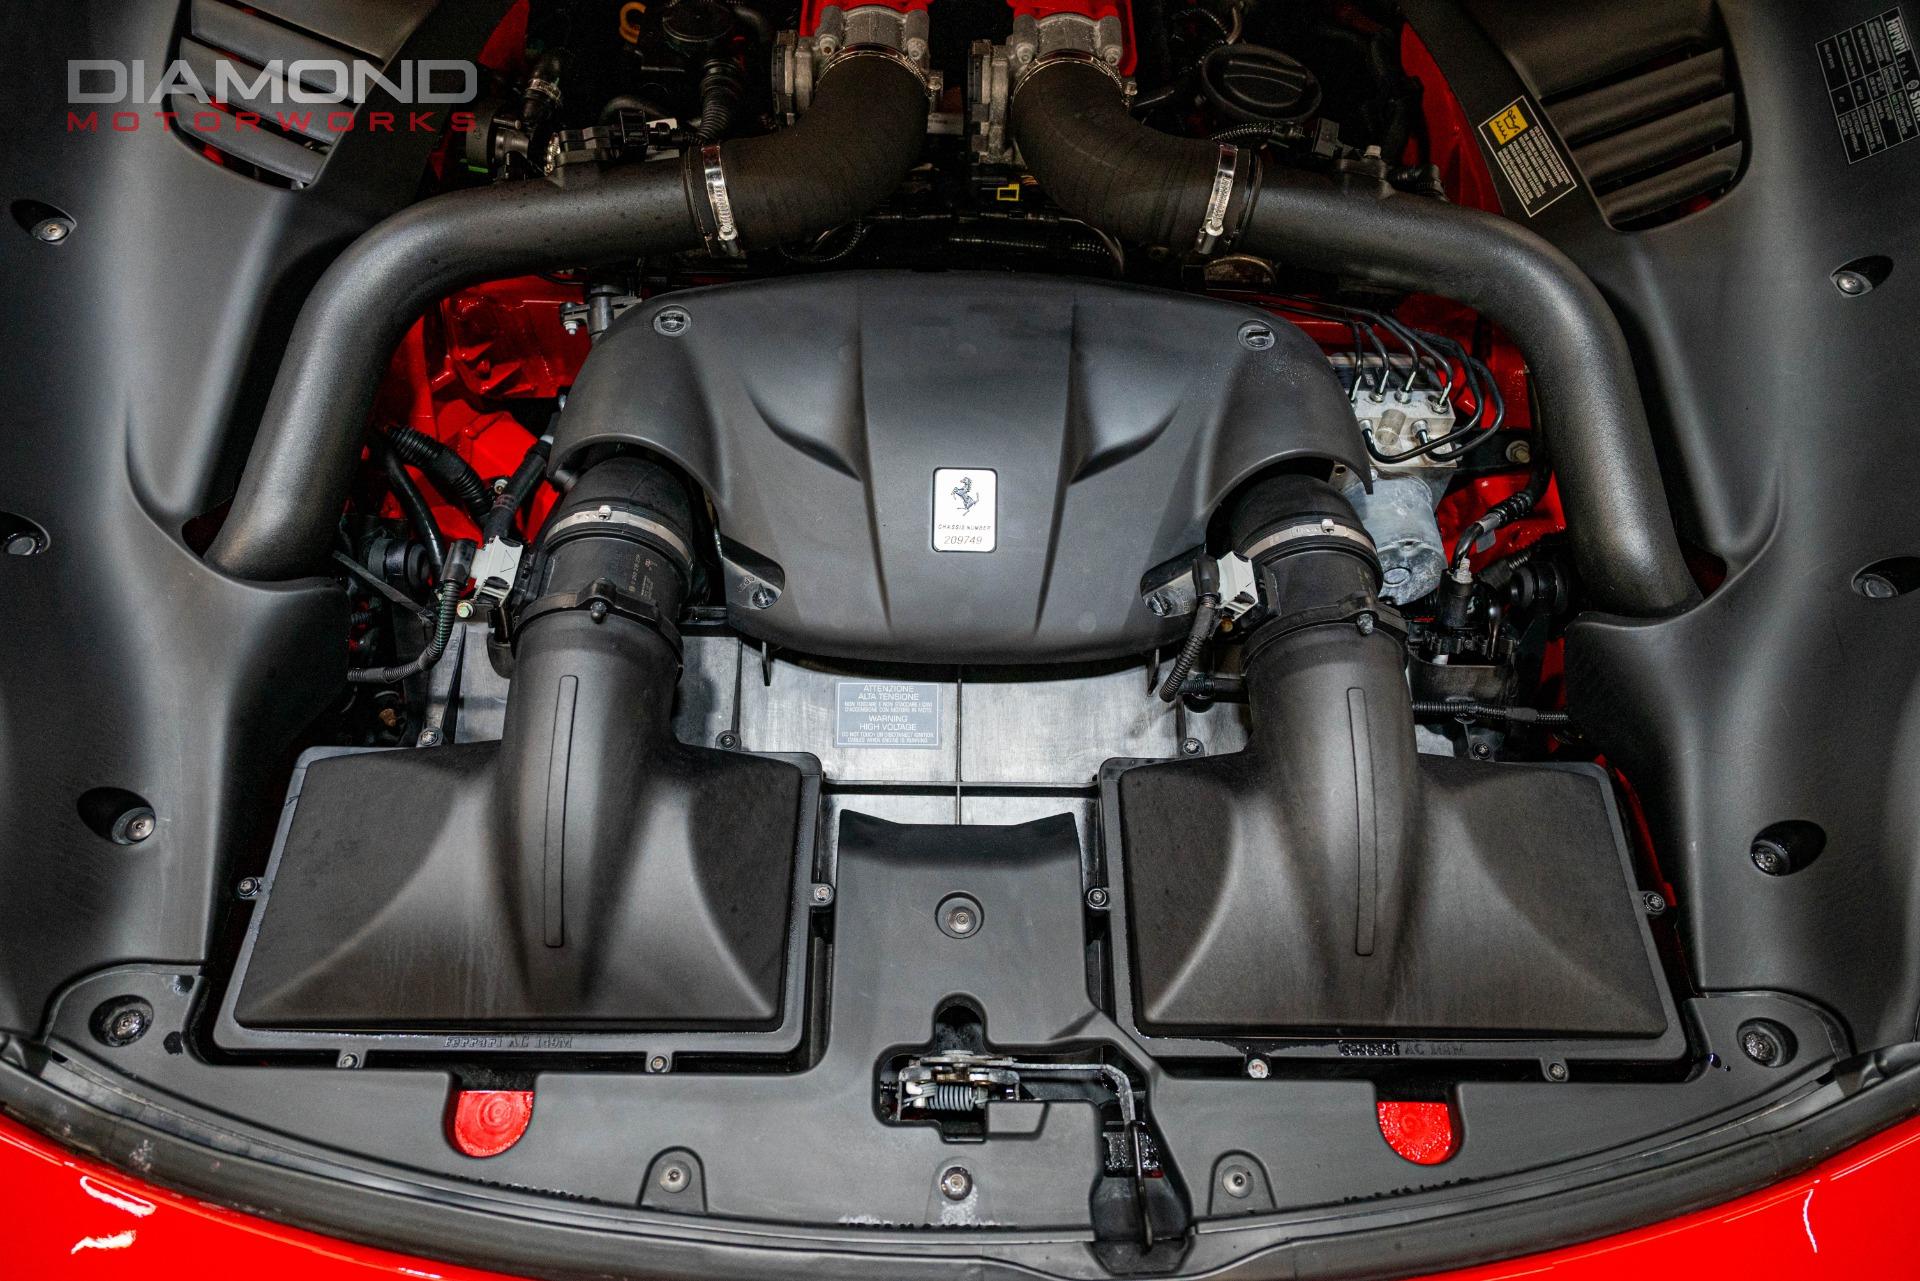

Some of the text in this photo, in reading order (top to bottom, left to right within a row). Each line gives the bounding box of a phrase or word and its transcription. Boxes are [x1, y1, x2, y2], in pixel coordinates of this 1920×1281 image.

[1885, 16, 1911, 56] Ferrari
[944, 535, 983, 545] 209749
[863, 684, 915, 693] ATTENZIONE
[858, 692, 920, 701] ALTA TENSIONE
[868, 714, 908, 723] WARNING
[859, 723, 917, 731] HIGH VOLTAGE
[443, 1035, 502, 1049] Ferrari
